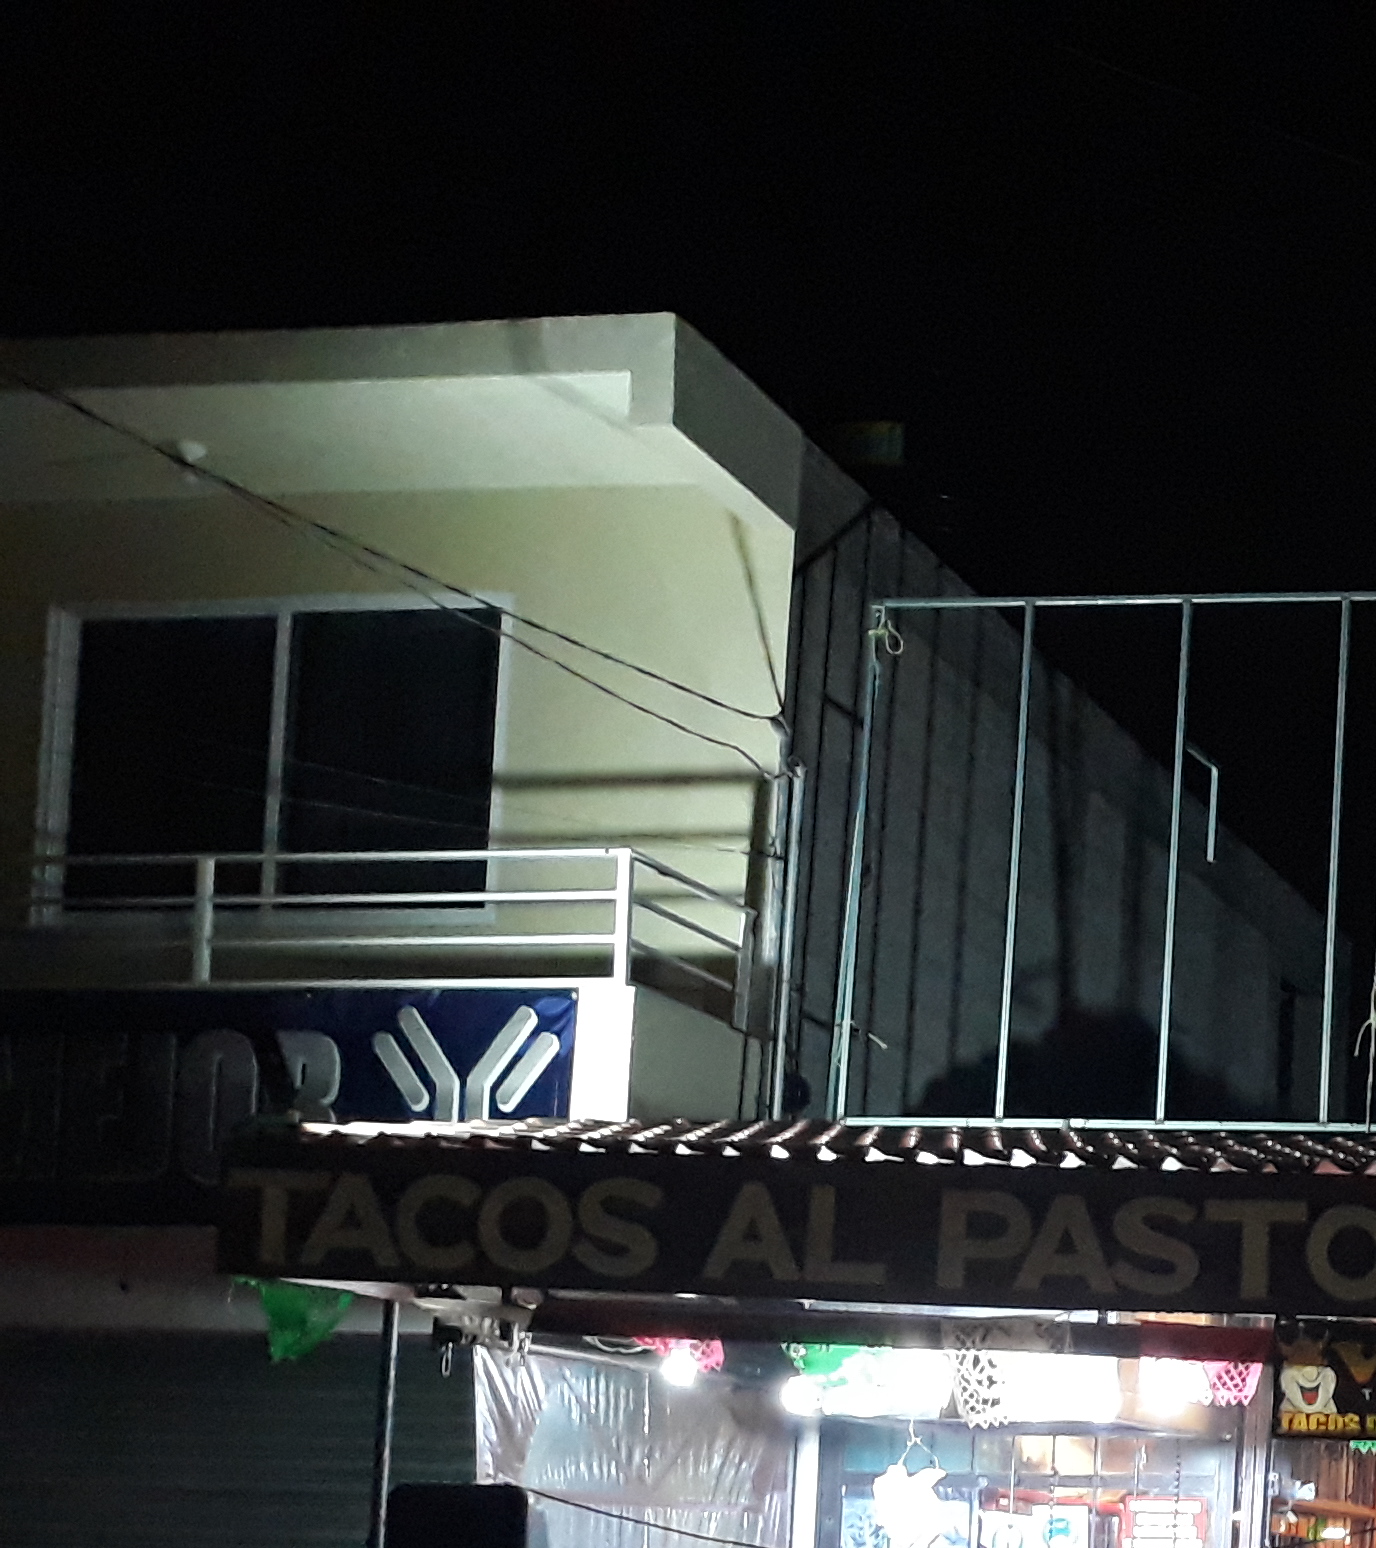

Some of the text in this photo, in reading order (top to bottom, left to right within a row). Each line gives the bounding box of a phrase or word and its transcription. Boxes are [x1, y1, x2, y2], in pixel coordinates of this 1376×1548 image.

[226, 1167, 662, 1277] TACOS
[700, 1181, 886, 1287] AL
[1281, 1412, 1360, 1431] TACOS
